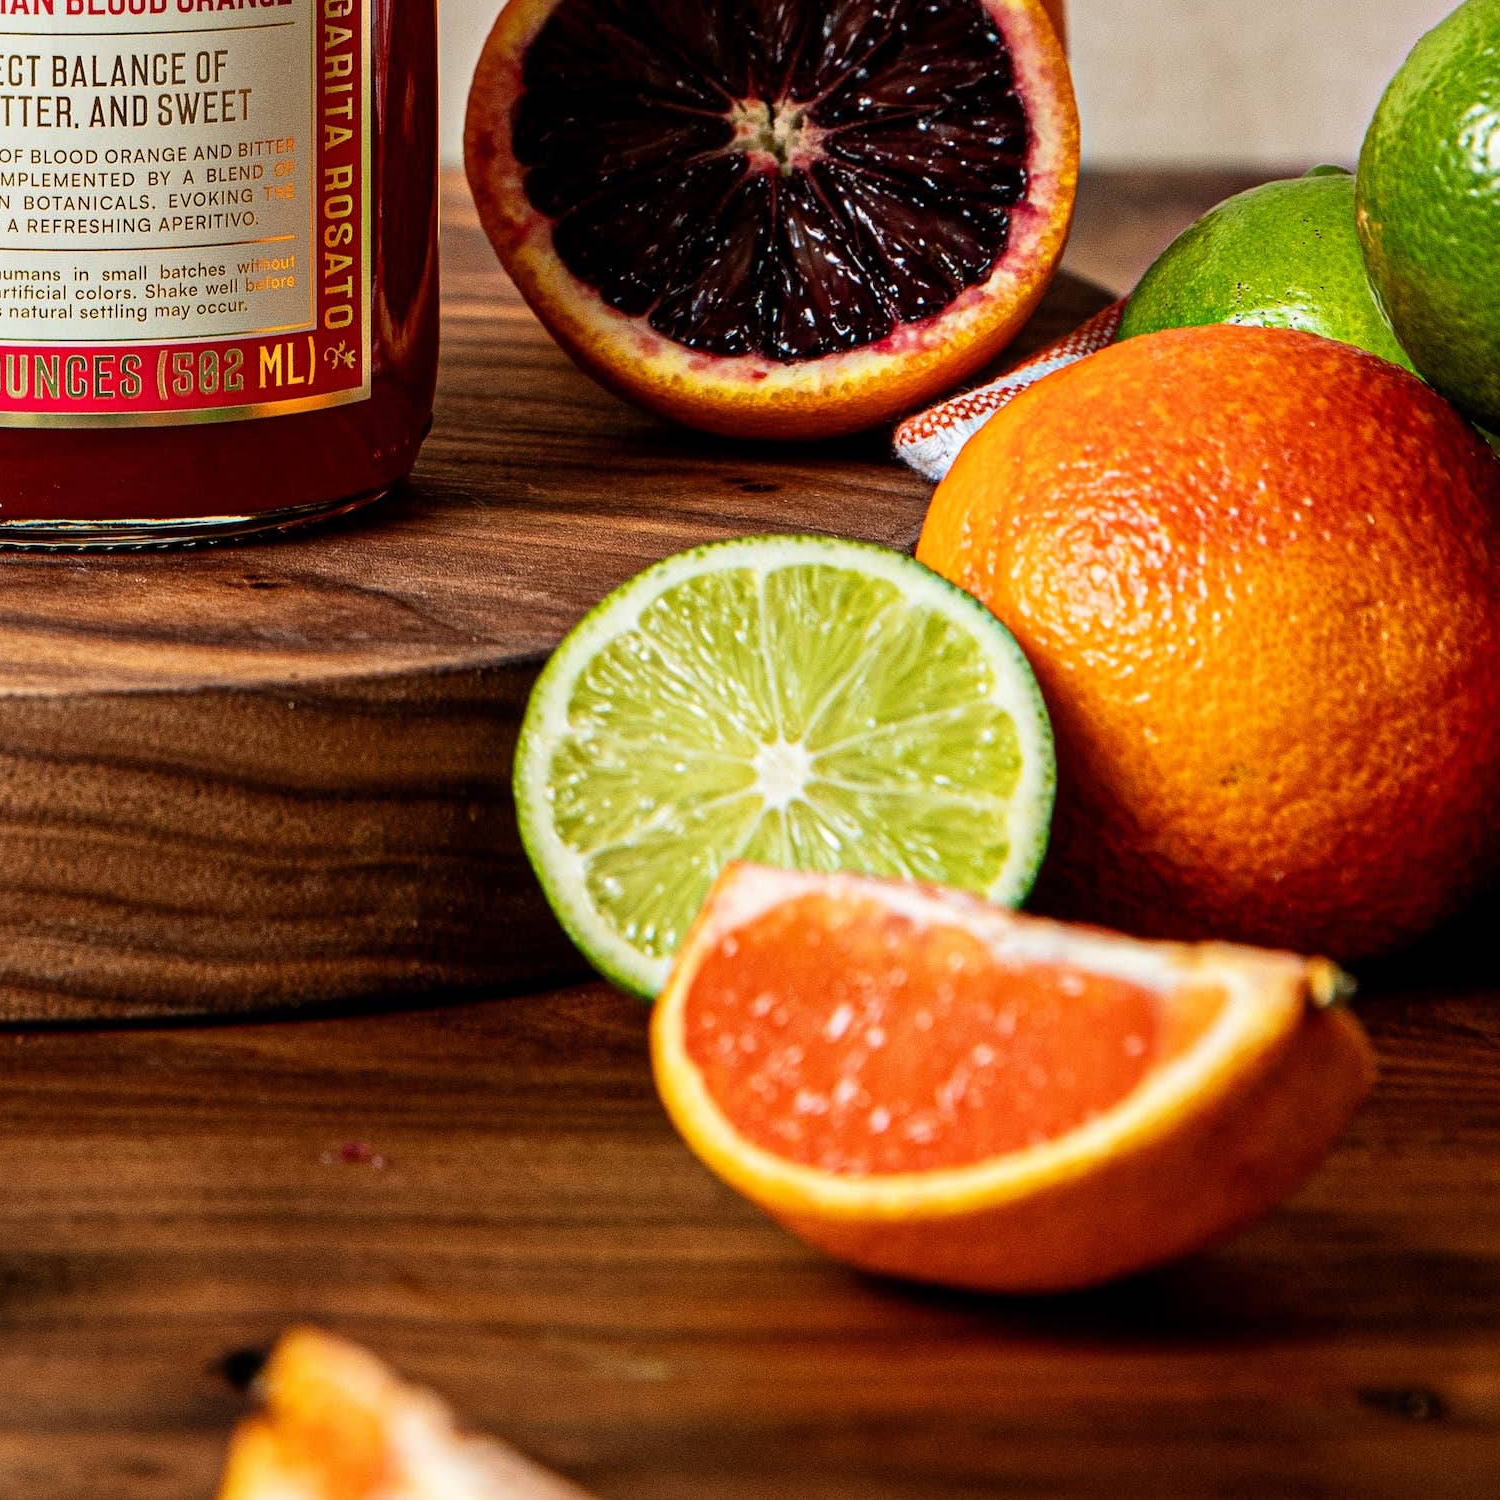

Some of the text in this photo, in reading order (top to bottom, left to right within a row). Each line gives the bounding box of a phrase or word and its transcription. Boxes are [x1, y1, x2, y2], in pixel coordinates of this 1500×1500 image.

[52, 52, 188, 89] BALANCE
[196, 48, 229, 85] OF
[89, 93, 149, 128] AND
[157, 88, 253, 125] SWEET
[31, 149, 98, 165] BLOOD
[105, 146, 187, 164] ORANGE
[194, 144, 232, 160] AND
[239, 137, 295, 158] BITTER
[148, 171, 171, 186] BY
[182, 170, 195, 184] A
[207, 165, 263, 182] BLEND
[274, 161, 295, 177] OF
[169, 188, 254, 209] EVOKING
[263, 183, 295, 201] THE
[7, 217, 20, 233] A
[27, 218, 151, 235] REFRESHING
[158, 211, 259, 232] APERITIVO.
[323, 164, 355, 330] ROSATO
[74, 267, 90, 281] in
[102, 265, 148, 281] small
[160, 262, 226, 280] batches
[237, 255, 296, 274] without
[75, 285, 138, 300] colors.
[145, 283, 198, 299] Shake
[205, 279, 239, 295] well
[245, 275, 295, 292] before
[9, 303, 73, 319] natural
[80, 303, 148, 322] settling
[154, 305, 191, 319] may
[196, 300, 249, 315] occur.
[157, 348, 244, 400] (502
[259, 335, 316, 388] ML)
